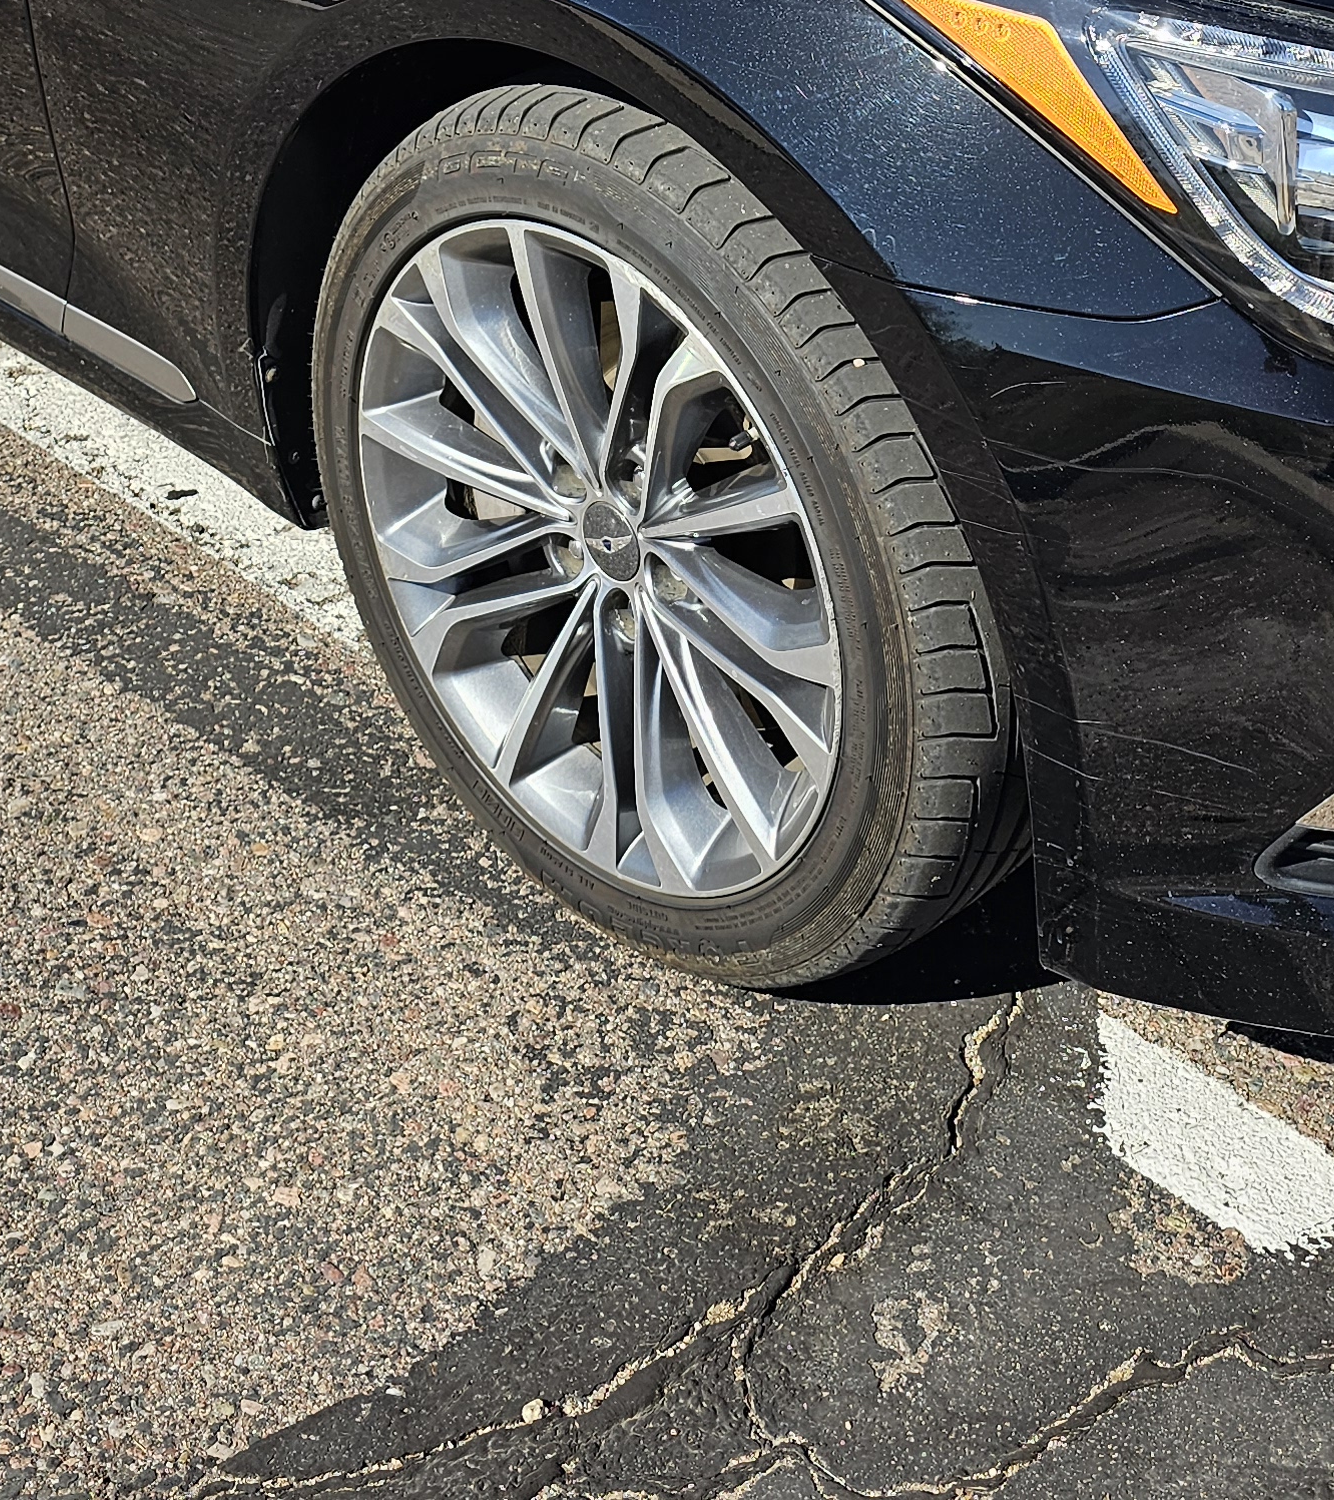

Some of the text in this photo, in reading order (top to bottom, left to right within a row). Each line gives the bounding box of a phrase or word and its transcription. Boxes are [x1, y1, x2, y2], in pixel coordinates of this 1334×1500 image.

[537, 846, 596, 892] ALL SEASON
[625, 899, 669, 922] OUTSIDE
